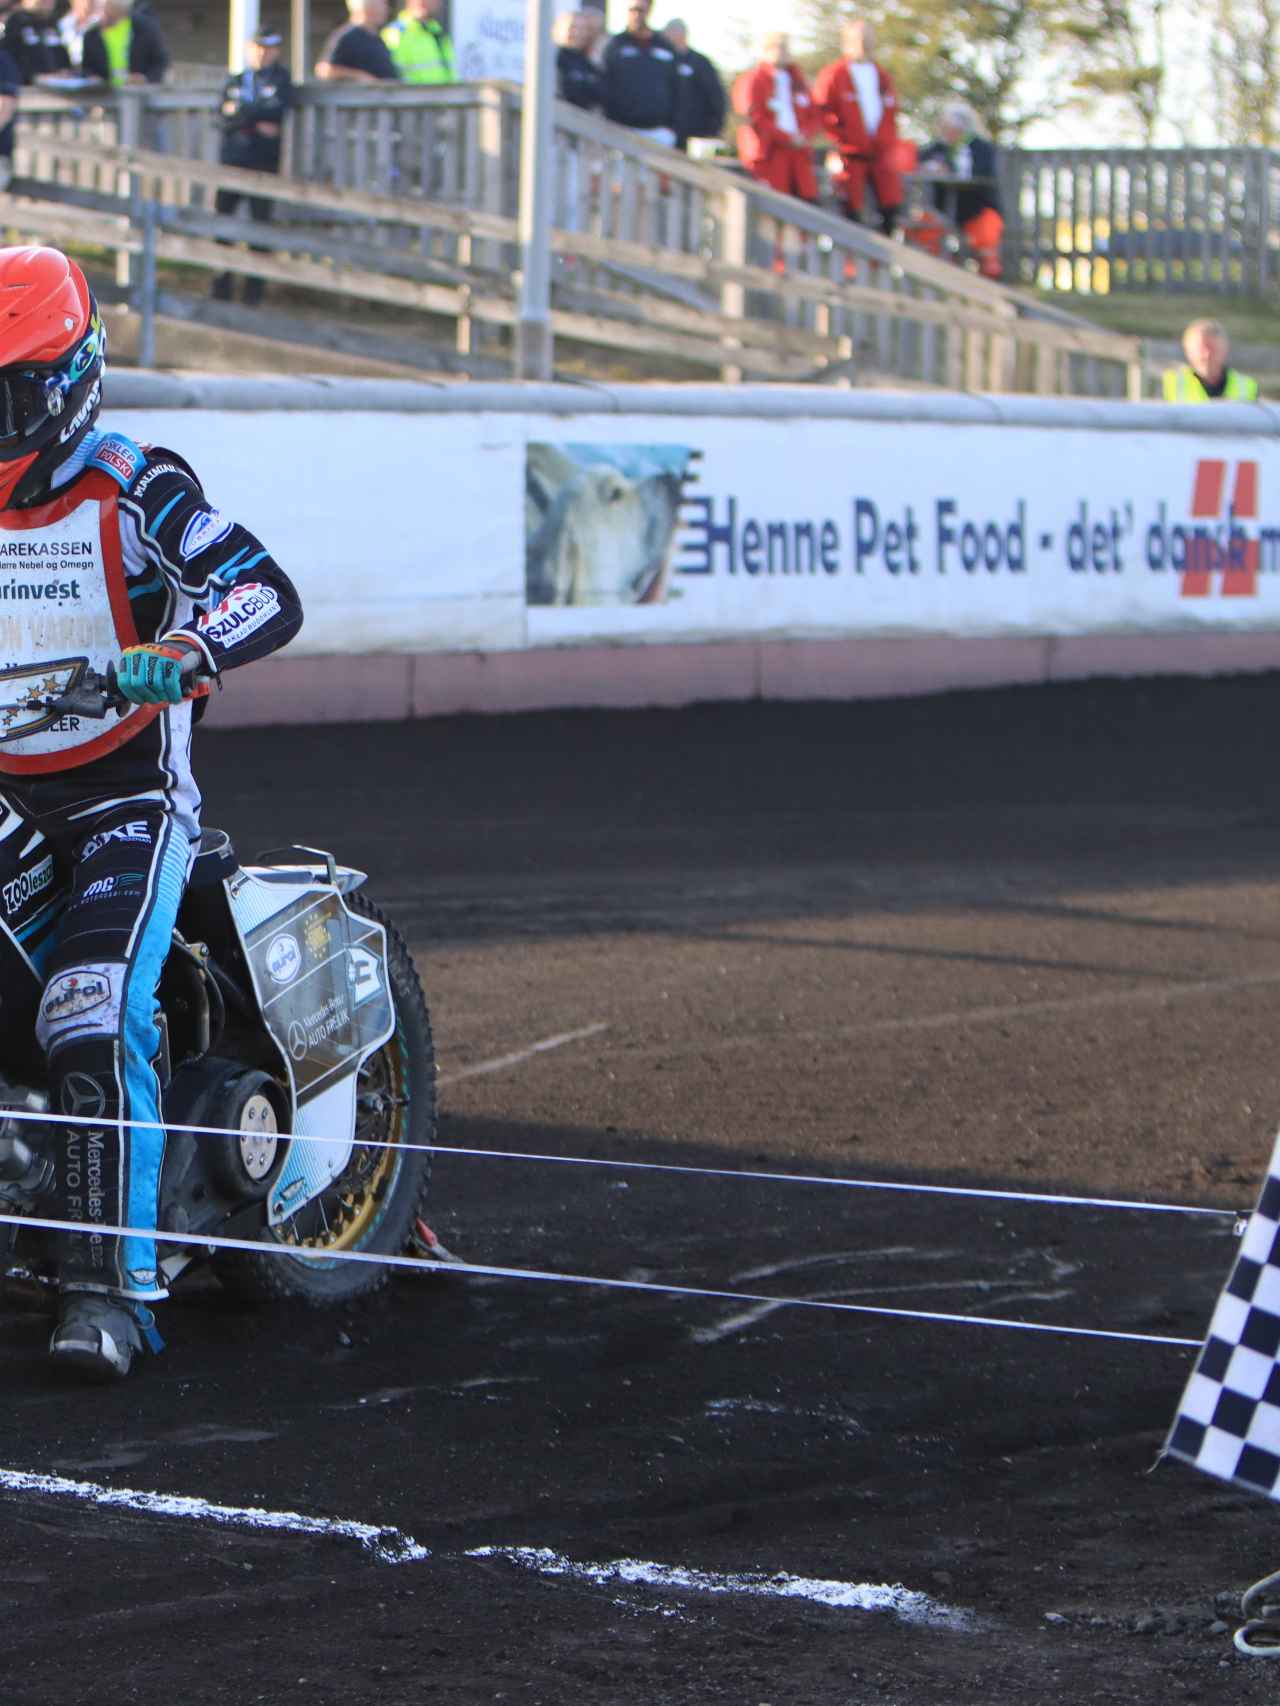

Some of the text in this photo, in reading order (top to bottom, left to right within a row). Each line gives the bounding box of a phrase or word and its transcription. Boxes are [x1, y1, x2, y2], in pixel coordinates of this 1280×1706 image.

[101, 451, 132, 478] POLSKI
[705, 496, 841, 576] Henne
[854, 497, 919, 576] Pet
[935, 498, 1026, 575] Food
[19, 560, 44, 570] Nebel
[46, 561, 59, 571] og
[60, 560, 95, 571] Omegn
[66, 1131, 81, 1187] AUTO
